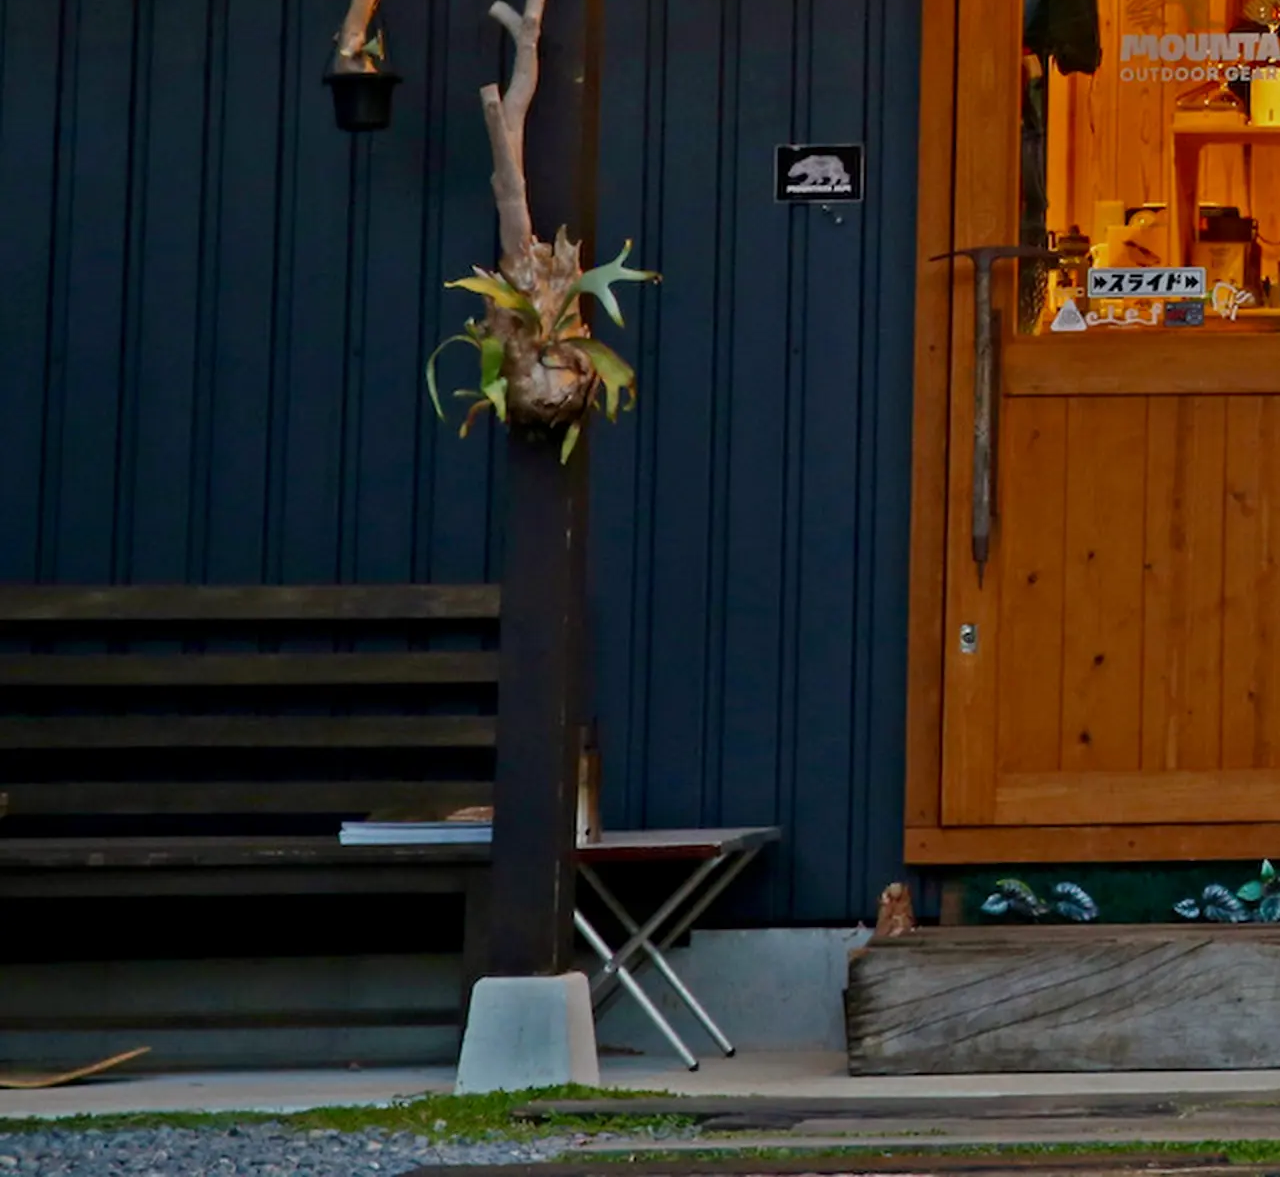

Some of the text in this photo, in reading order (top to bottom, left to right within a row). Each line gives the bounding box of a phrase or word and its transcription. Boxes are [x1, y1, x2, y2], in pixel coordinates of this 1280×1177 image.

[1119, 66, 1219, 83] OUTDOOR
[1224, 65, 1277, 81] GEAR
[1108, 273, 1181, 292] スライド
